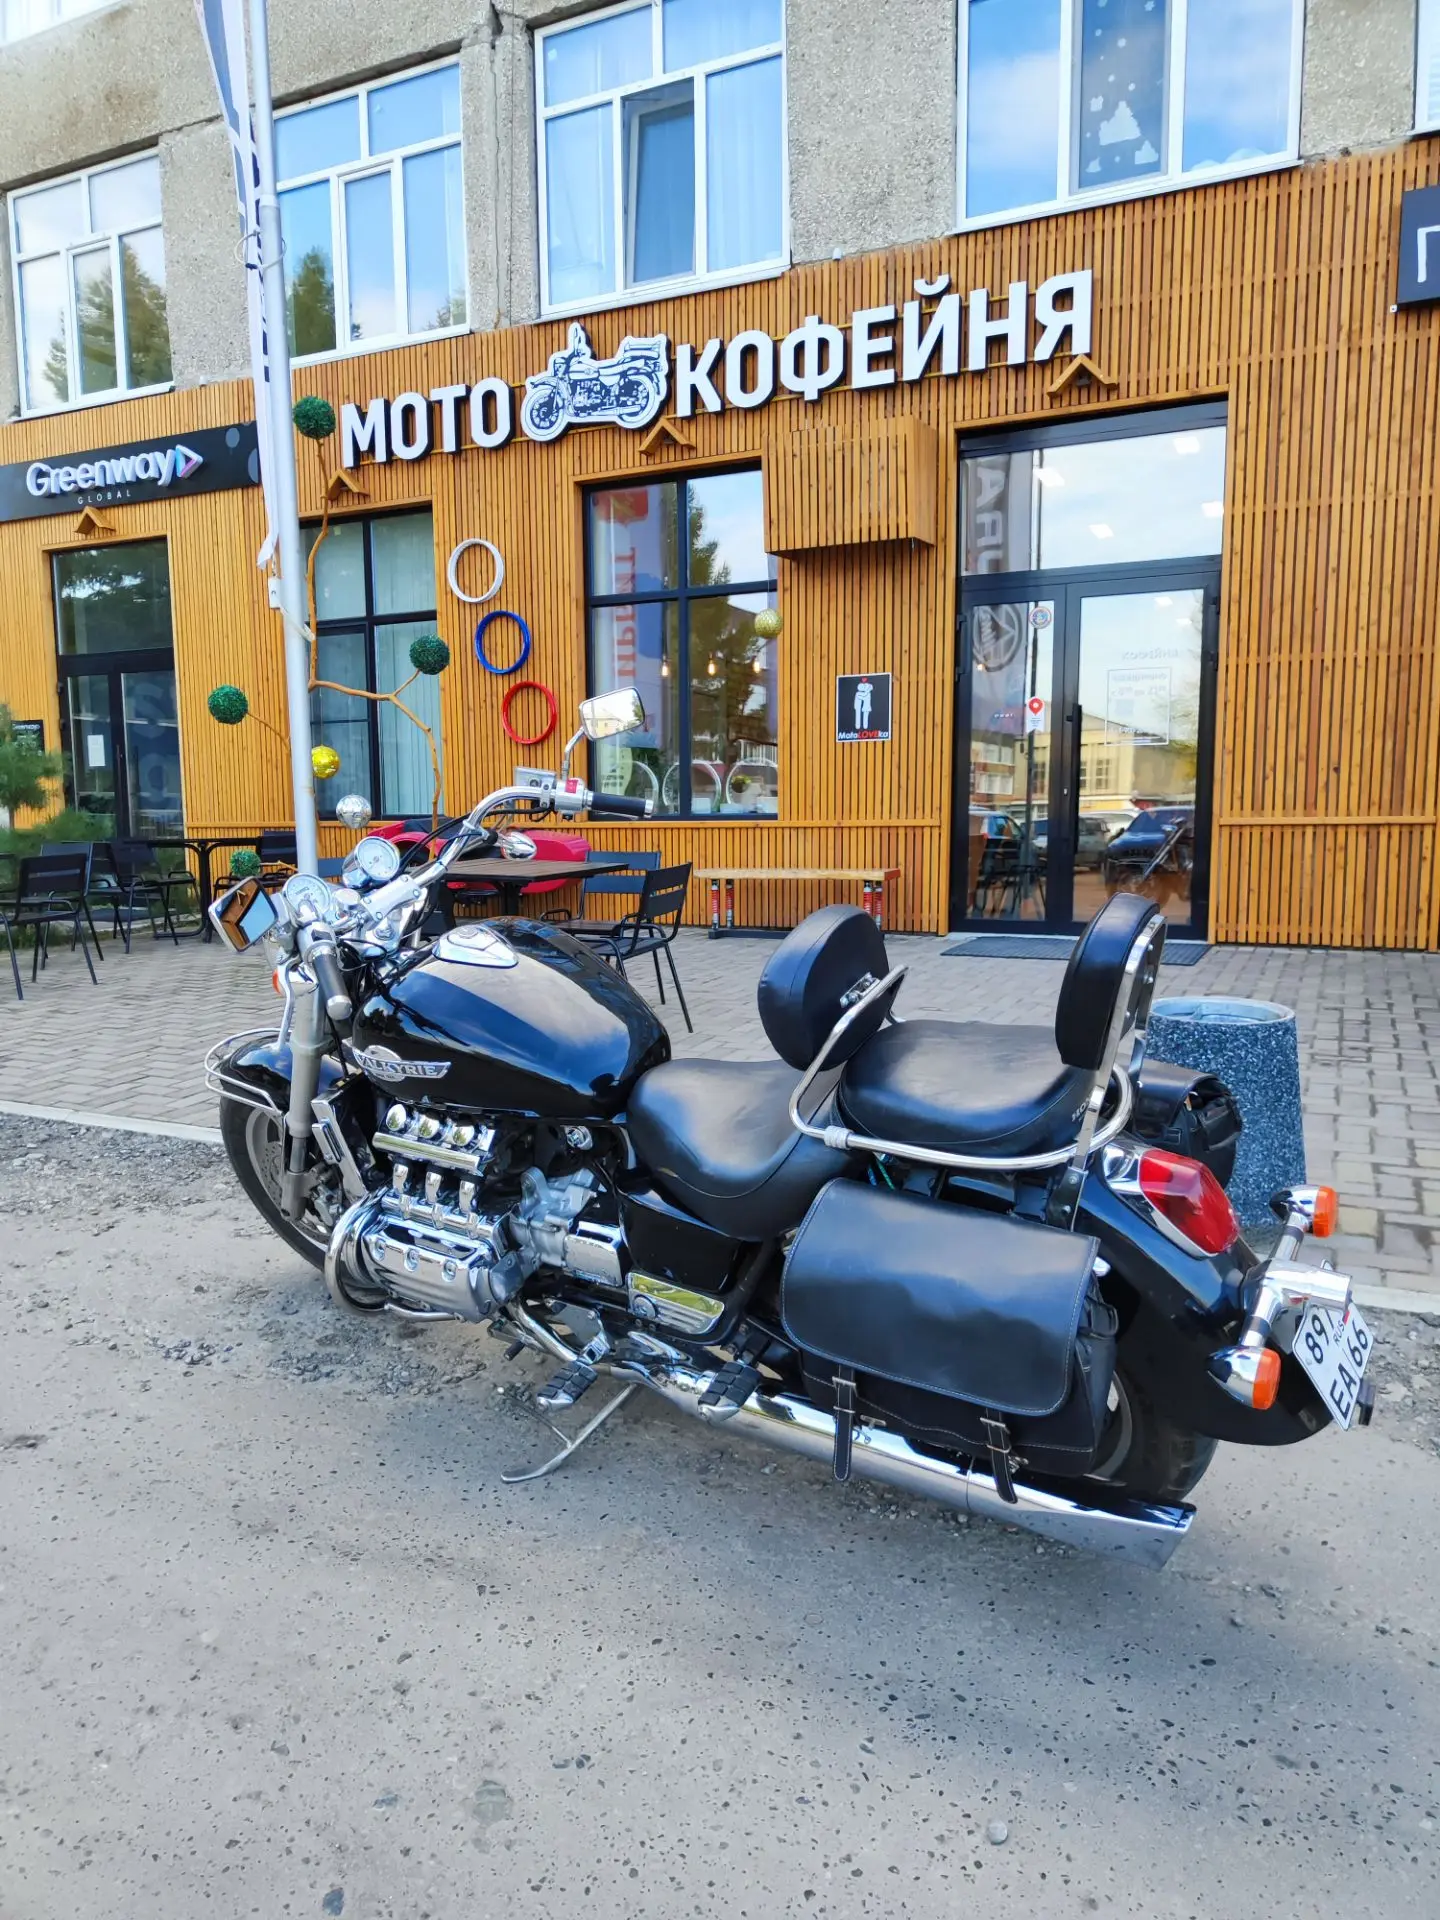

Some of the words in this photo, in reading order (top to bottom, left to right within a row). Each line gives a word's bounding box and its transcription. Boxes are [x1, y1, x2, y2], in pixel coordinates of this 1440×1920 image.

[341, 377, 513, 469] МОТО
[676, 269, 1092, 418] КОФЕЙНЯ
[26, 448, 176, 497] Greenway
[78, 489, 131, 505] GLOBAL
[355, 1053, 438, 1076] VALKYRIE
[1332, 1322, 1345, 1346] RUS
[1347, 1320, 1368, 1367] 66
